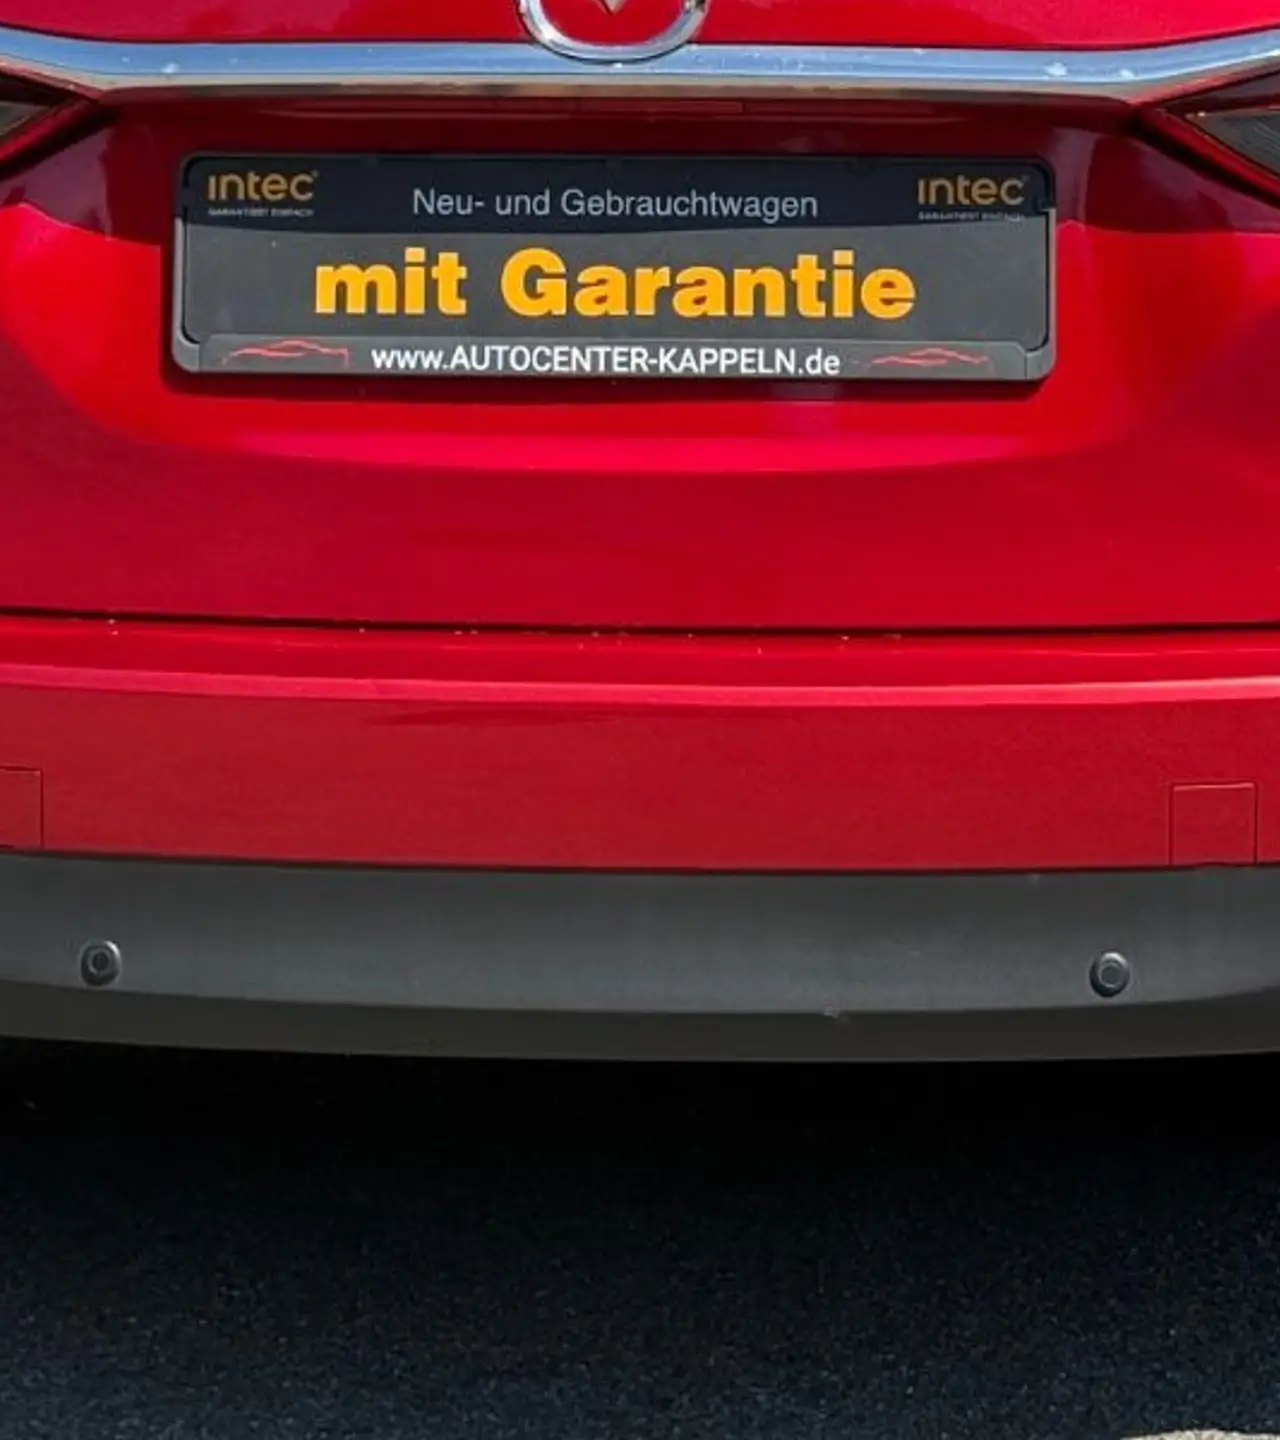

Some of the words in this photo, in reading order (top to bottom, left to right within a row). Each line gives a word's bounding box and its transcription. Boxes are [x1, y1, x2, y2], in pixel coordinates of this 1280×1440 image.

[207, 170, 316, 202] intec
[917, 173, 1025, 206] intec
[412, 188, 486, 218] Neu-
[493, 188, 553, 218] und
[559, 188, 819, 226] Gebrauchtwagen
[314, 246, 469, 316] mit
[499, 247, 918, 321] Garantie
[371, 341, 842, 378] www.AUTOCENTER-KAPPELN.de
